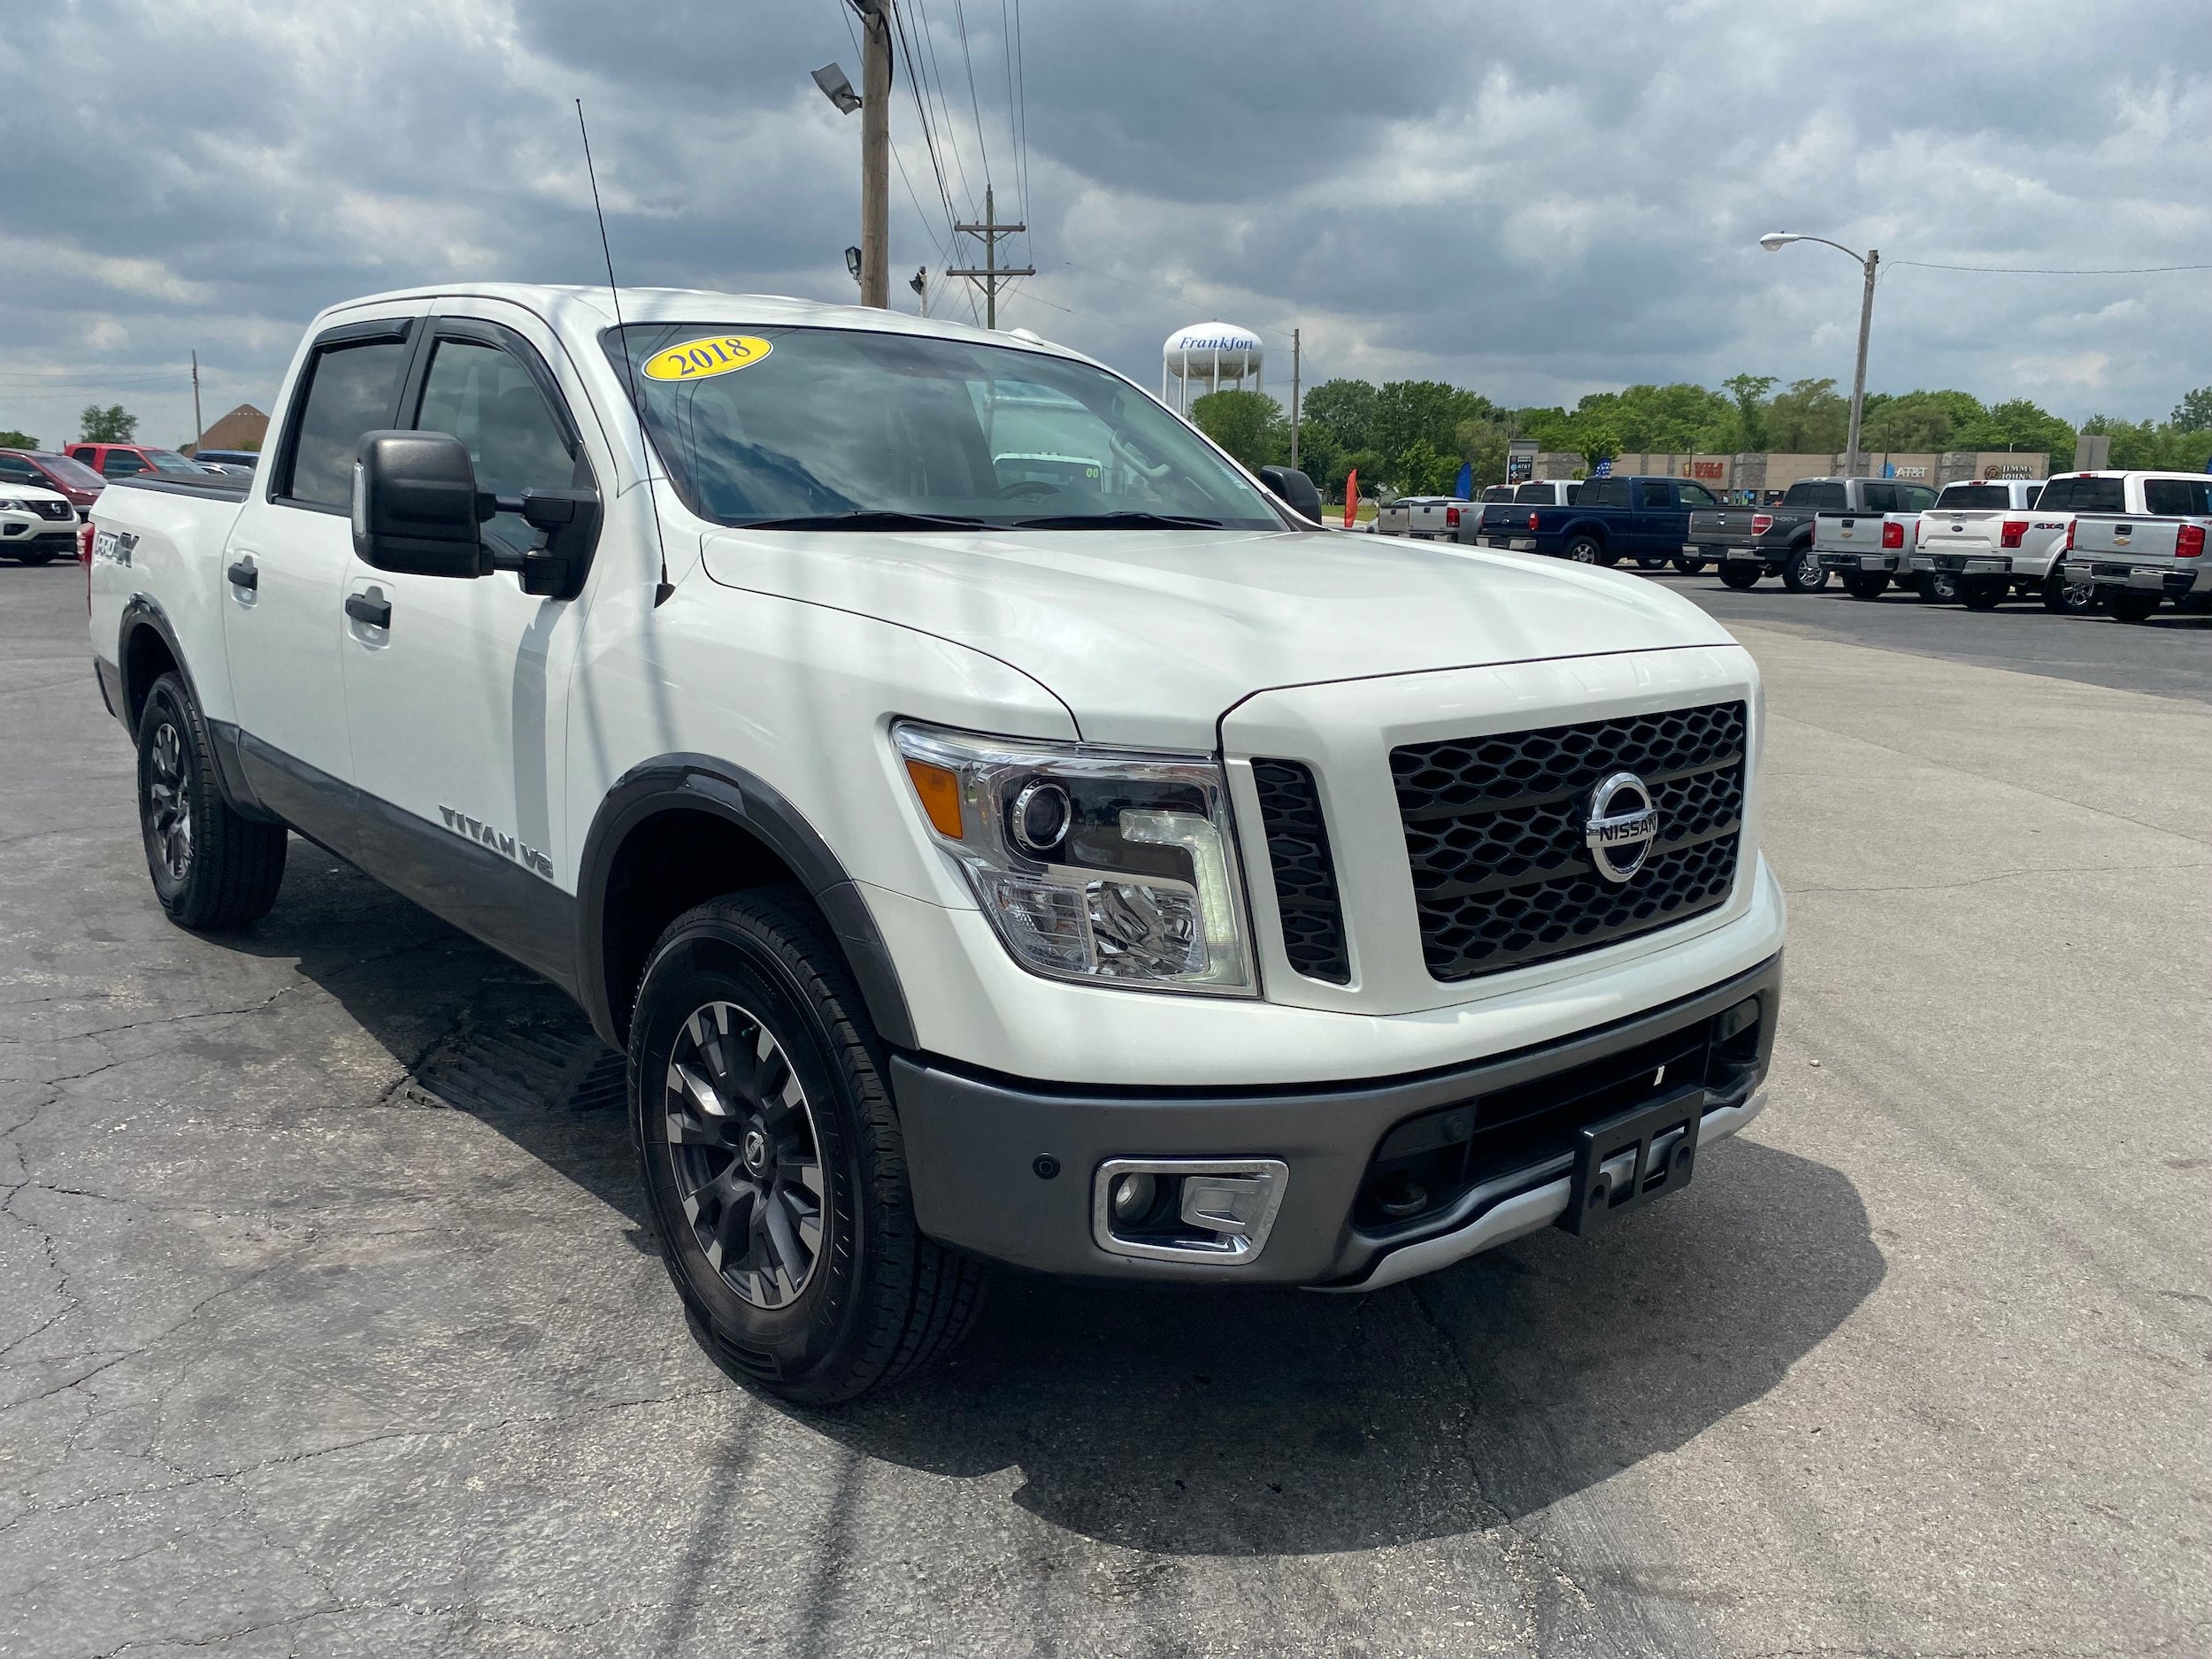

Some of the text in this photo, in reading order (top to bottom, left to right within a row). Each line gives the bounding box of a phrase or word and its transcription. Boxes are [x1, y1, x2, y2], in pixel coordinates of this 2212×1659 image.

[1179, 336, 1253, 351] Frankfort
[668, 339, 750, 376] 2018
[1896, 466, 1928, 478] AT&T
[439, 803, 554, 879] TITAN V8
[1600, 815, 1656, 841] NISSAN
